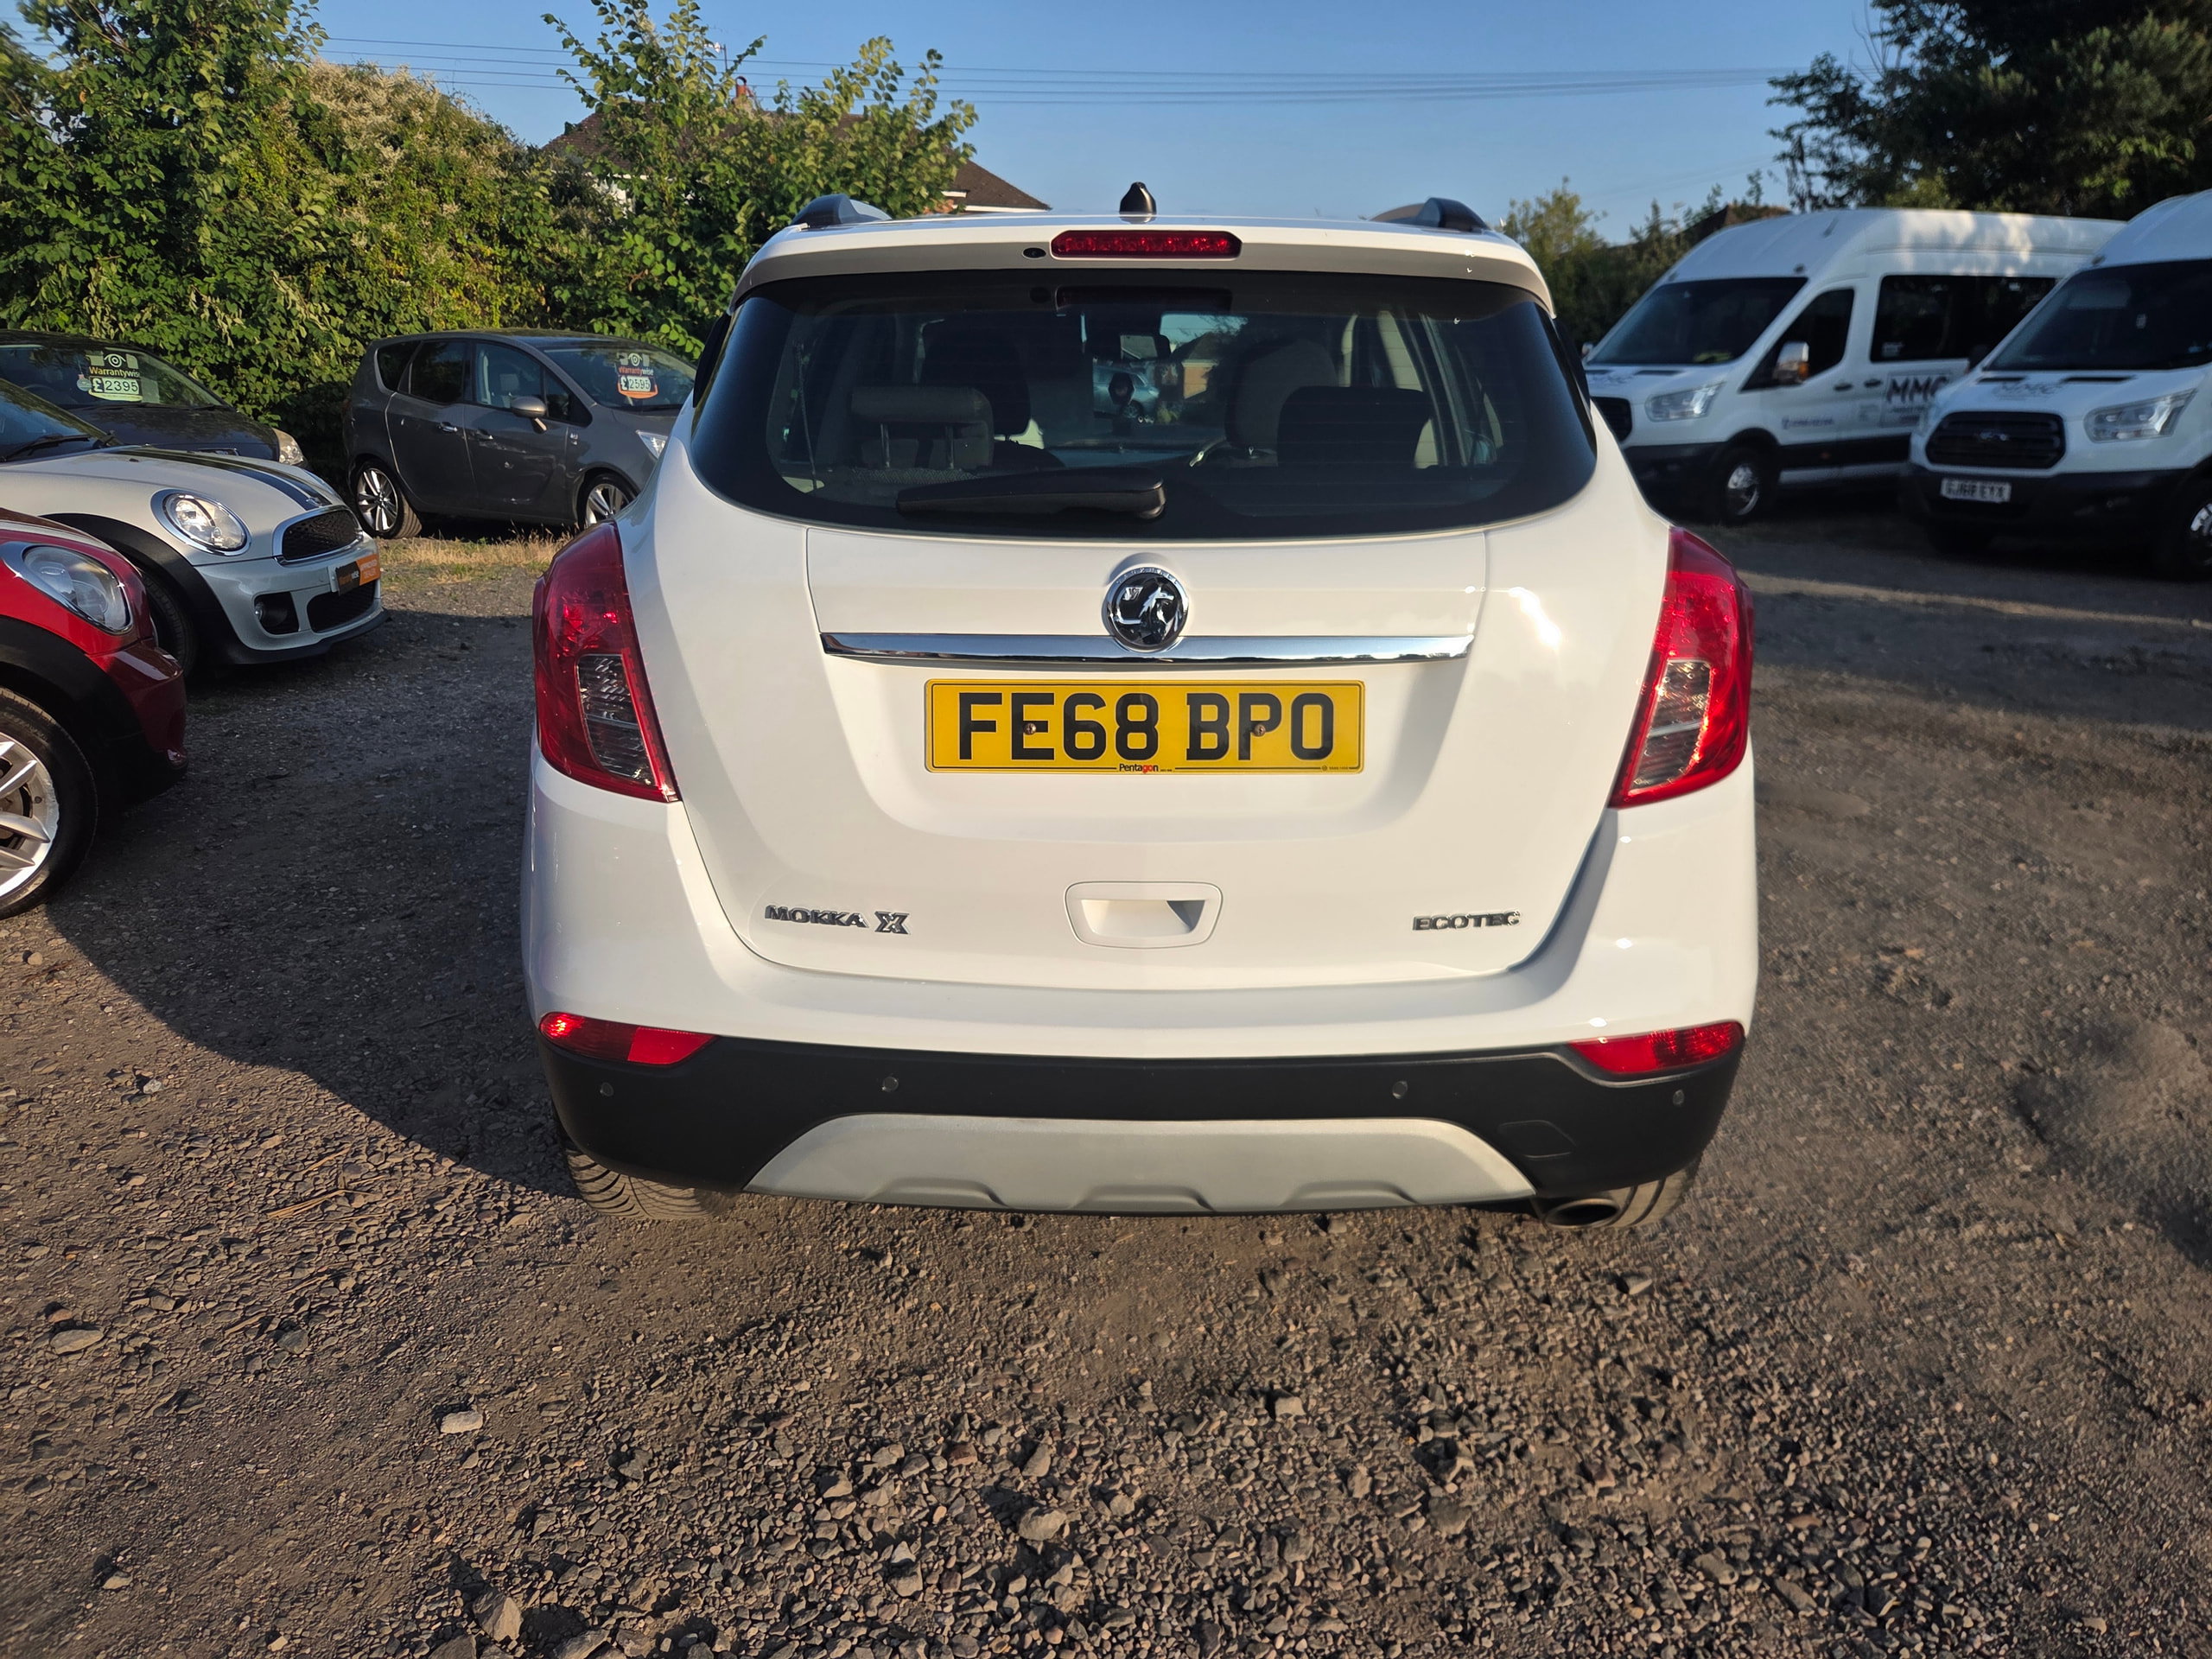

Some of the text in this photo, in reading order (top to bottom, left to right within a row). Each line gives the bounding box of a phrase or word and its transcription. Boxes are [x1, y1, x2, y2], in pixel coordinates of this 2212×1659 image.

[92, 378, 138, 392] £2395
[958, 691, 1334, 761] FE68 BPO
[1119, 763, 1160, 774] Pentagon
[765, 905, 911, 935] MOKKA X
[1412, 910, 1521, 931] ECOTEC
